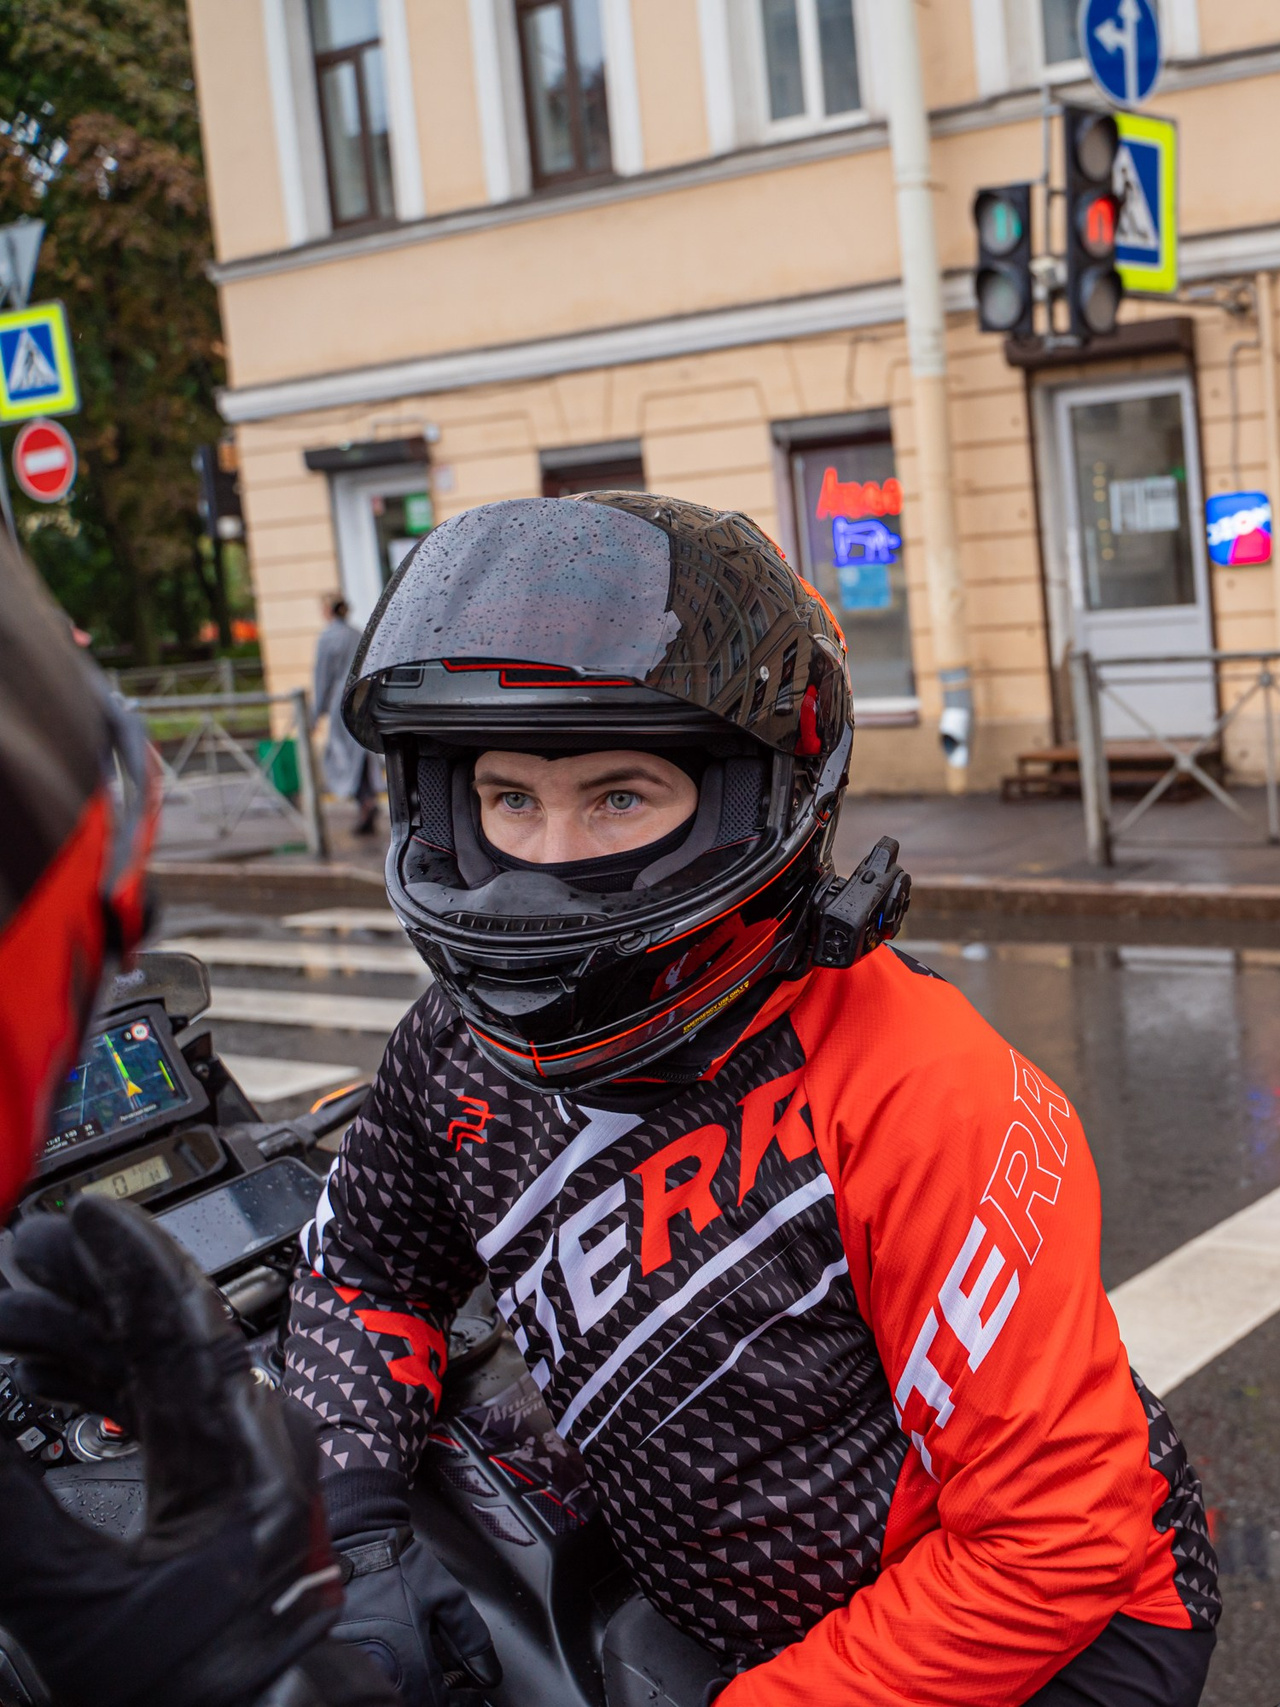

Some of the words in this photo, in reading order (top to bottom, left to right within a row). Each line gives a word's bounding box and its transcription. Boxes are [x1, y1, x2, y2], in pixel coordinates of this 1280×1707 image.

[682, 1003, 719, 1031] EMERGENCY
[717, 995, 730, 1006] USE
[728, 984, 745, 998] ONLY
[894, 1049, 1070, 1440] TERR
